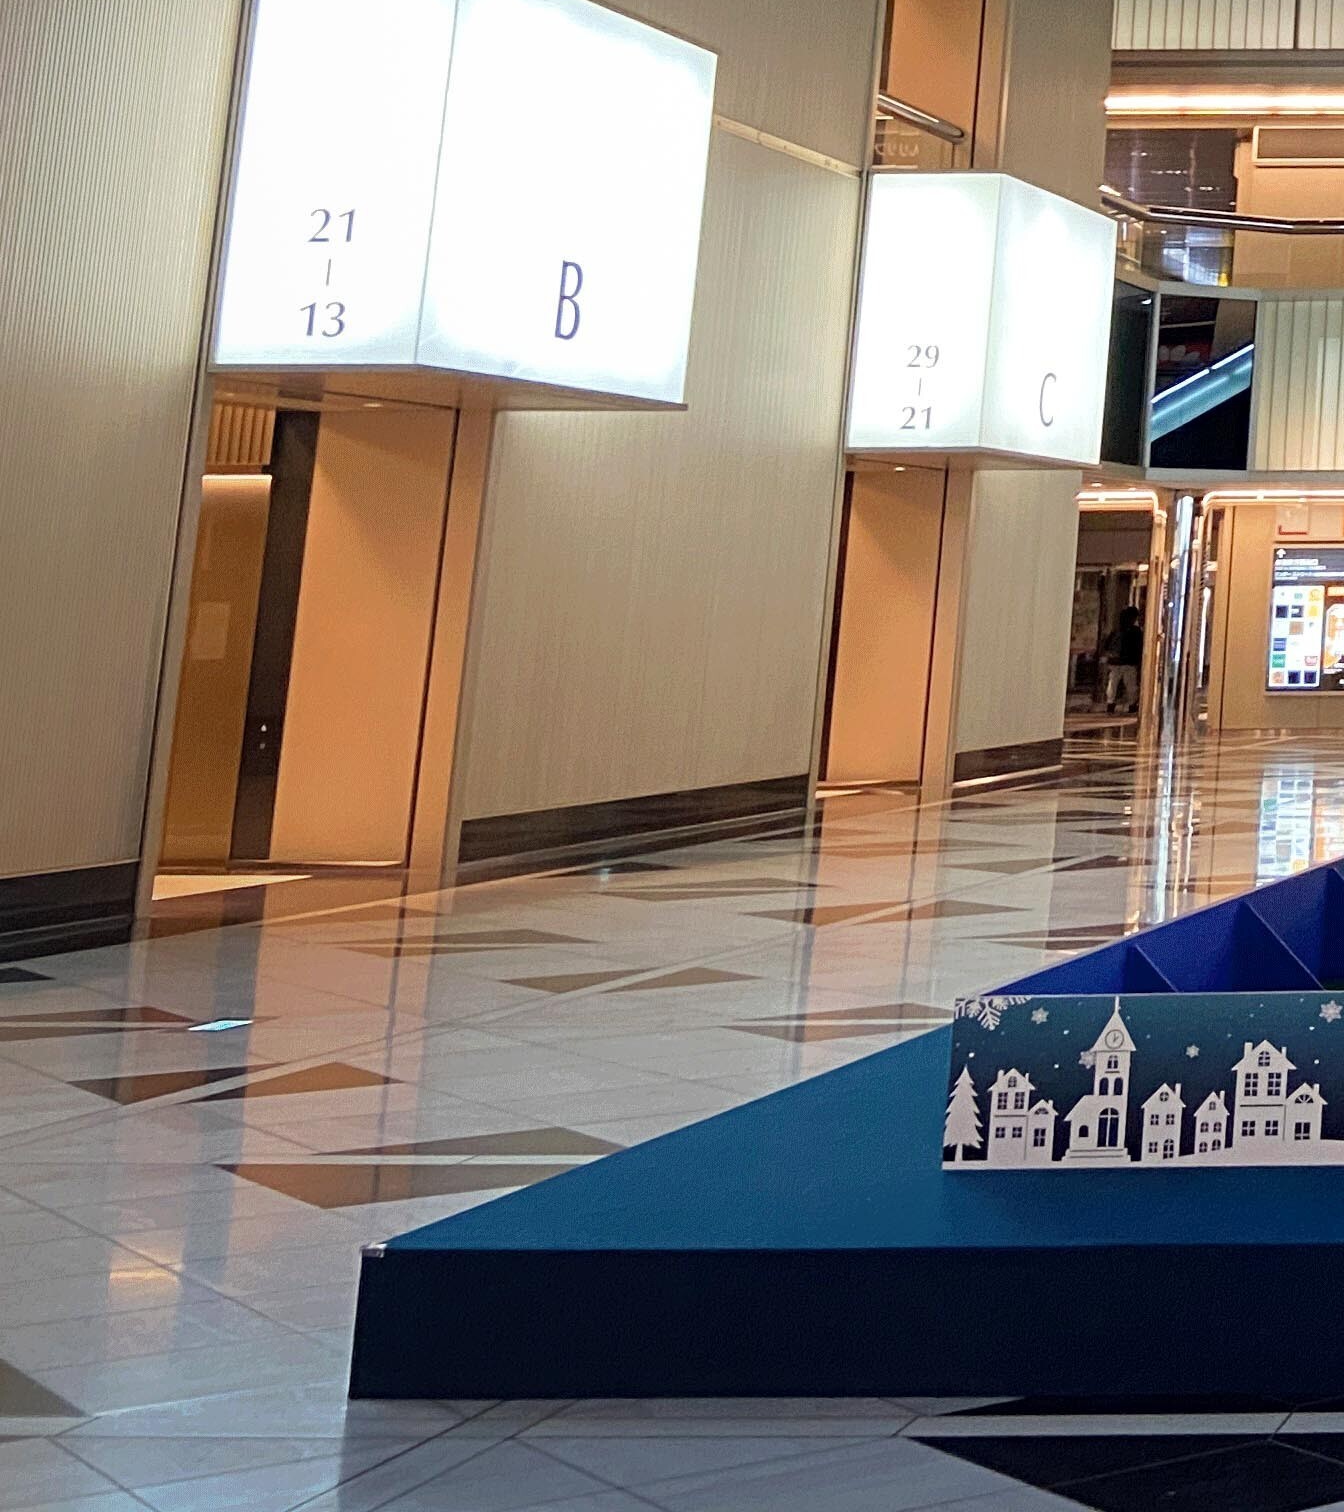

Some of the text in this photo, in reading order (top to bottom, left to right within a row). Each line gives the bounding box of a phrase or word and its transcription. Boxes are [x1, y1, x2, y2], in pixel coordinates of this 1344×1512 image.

[308, 208, 355, 243] 21
[554, 260, 583, 340] B
[300, 302, 346, 338] 13
[906, 345, 940, 368] 29
[1039, 372, 1057, 427] C
[900, 406, 932, 430] 21
